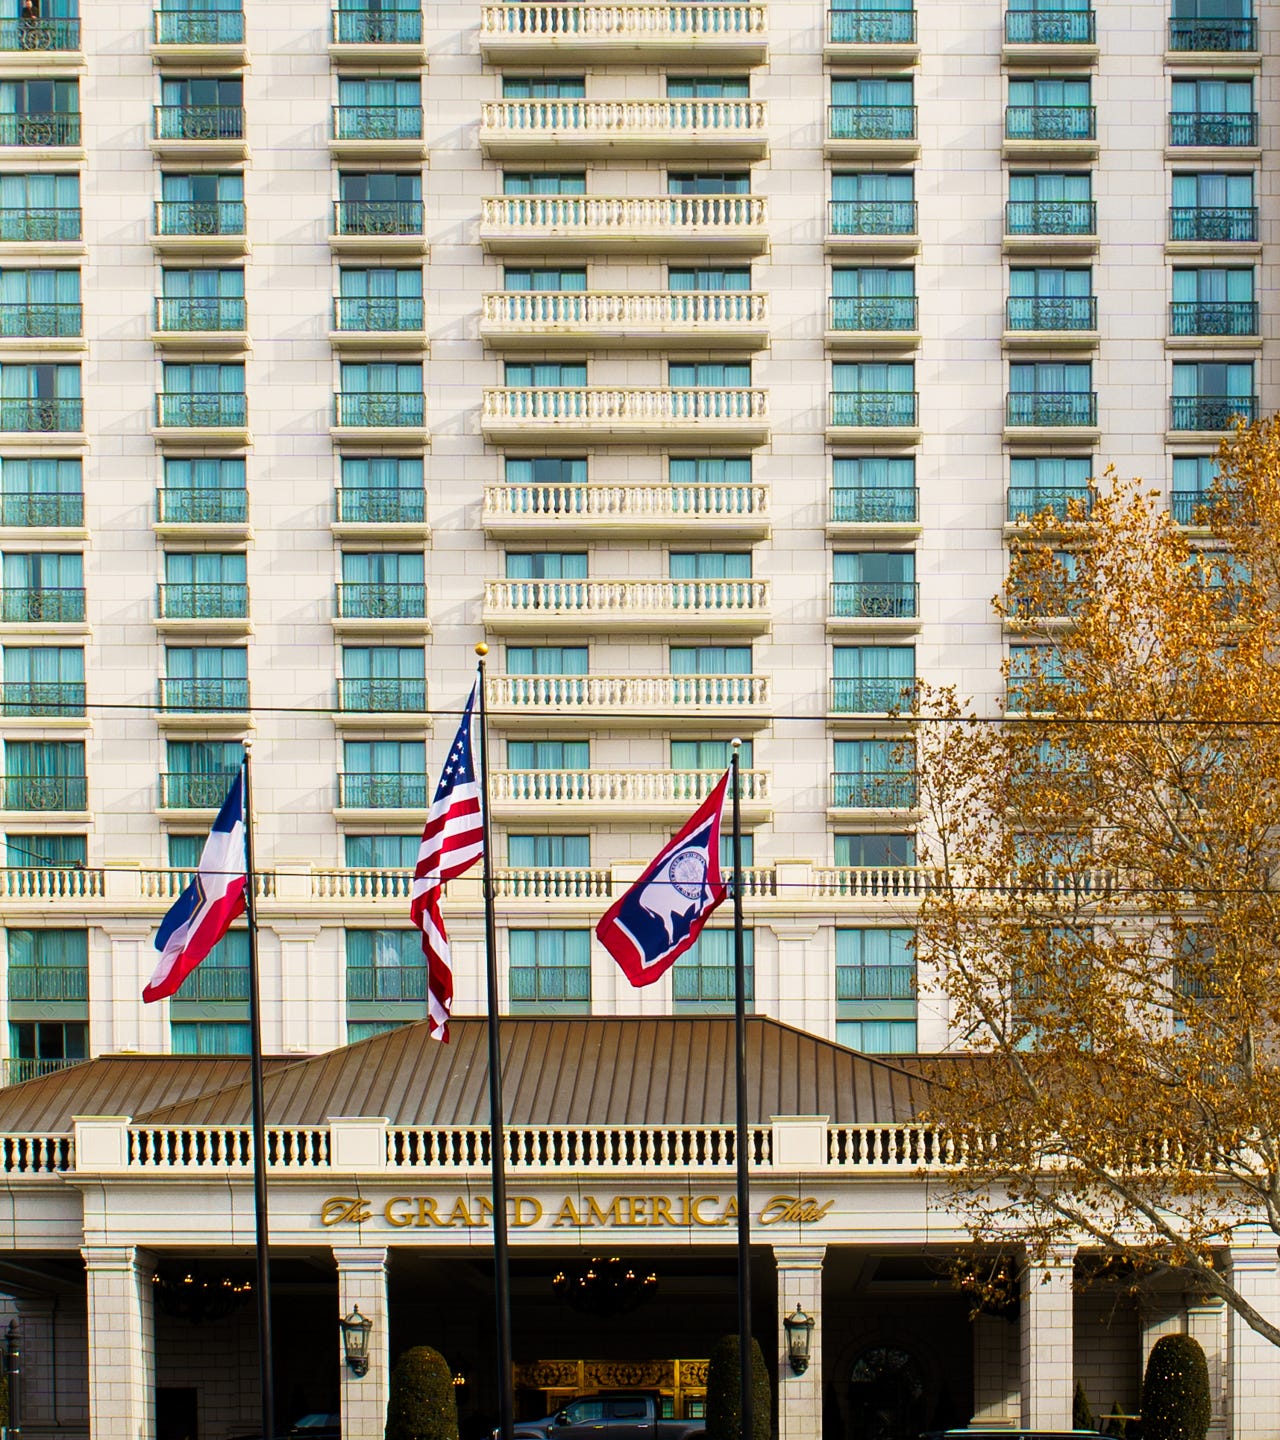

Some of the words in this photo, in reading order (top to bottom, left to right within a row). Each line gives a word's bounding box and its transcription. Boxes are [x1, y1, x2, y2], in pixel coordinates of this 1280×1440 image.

[320, 1196, 372, 1227] The
[384, 1196, 543, 1227] GRAND
[759, 1195, 835, 1225] Hotel
